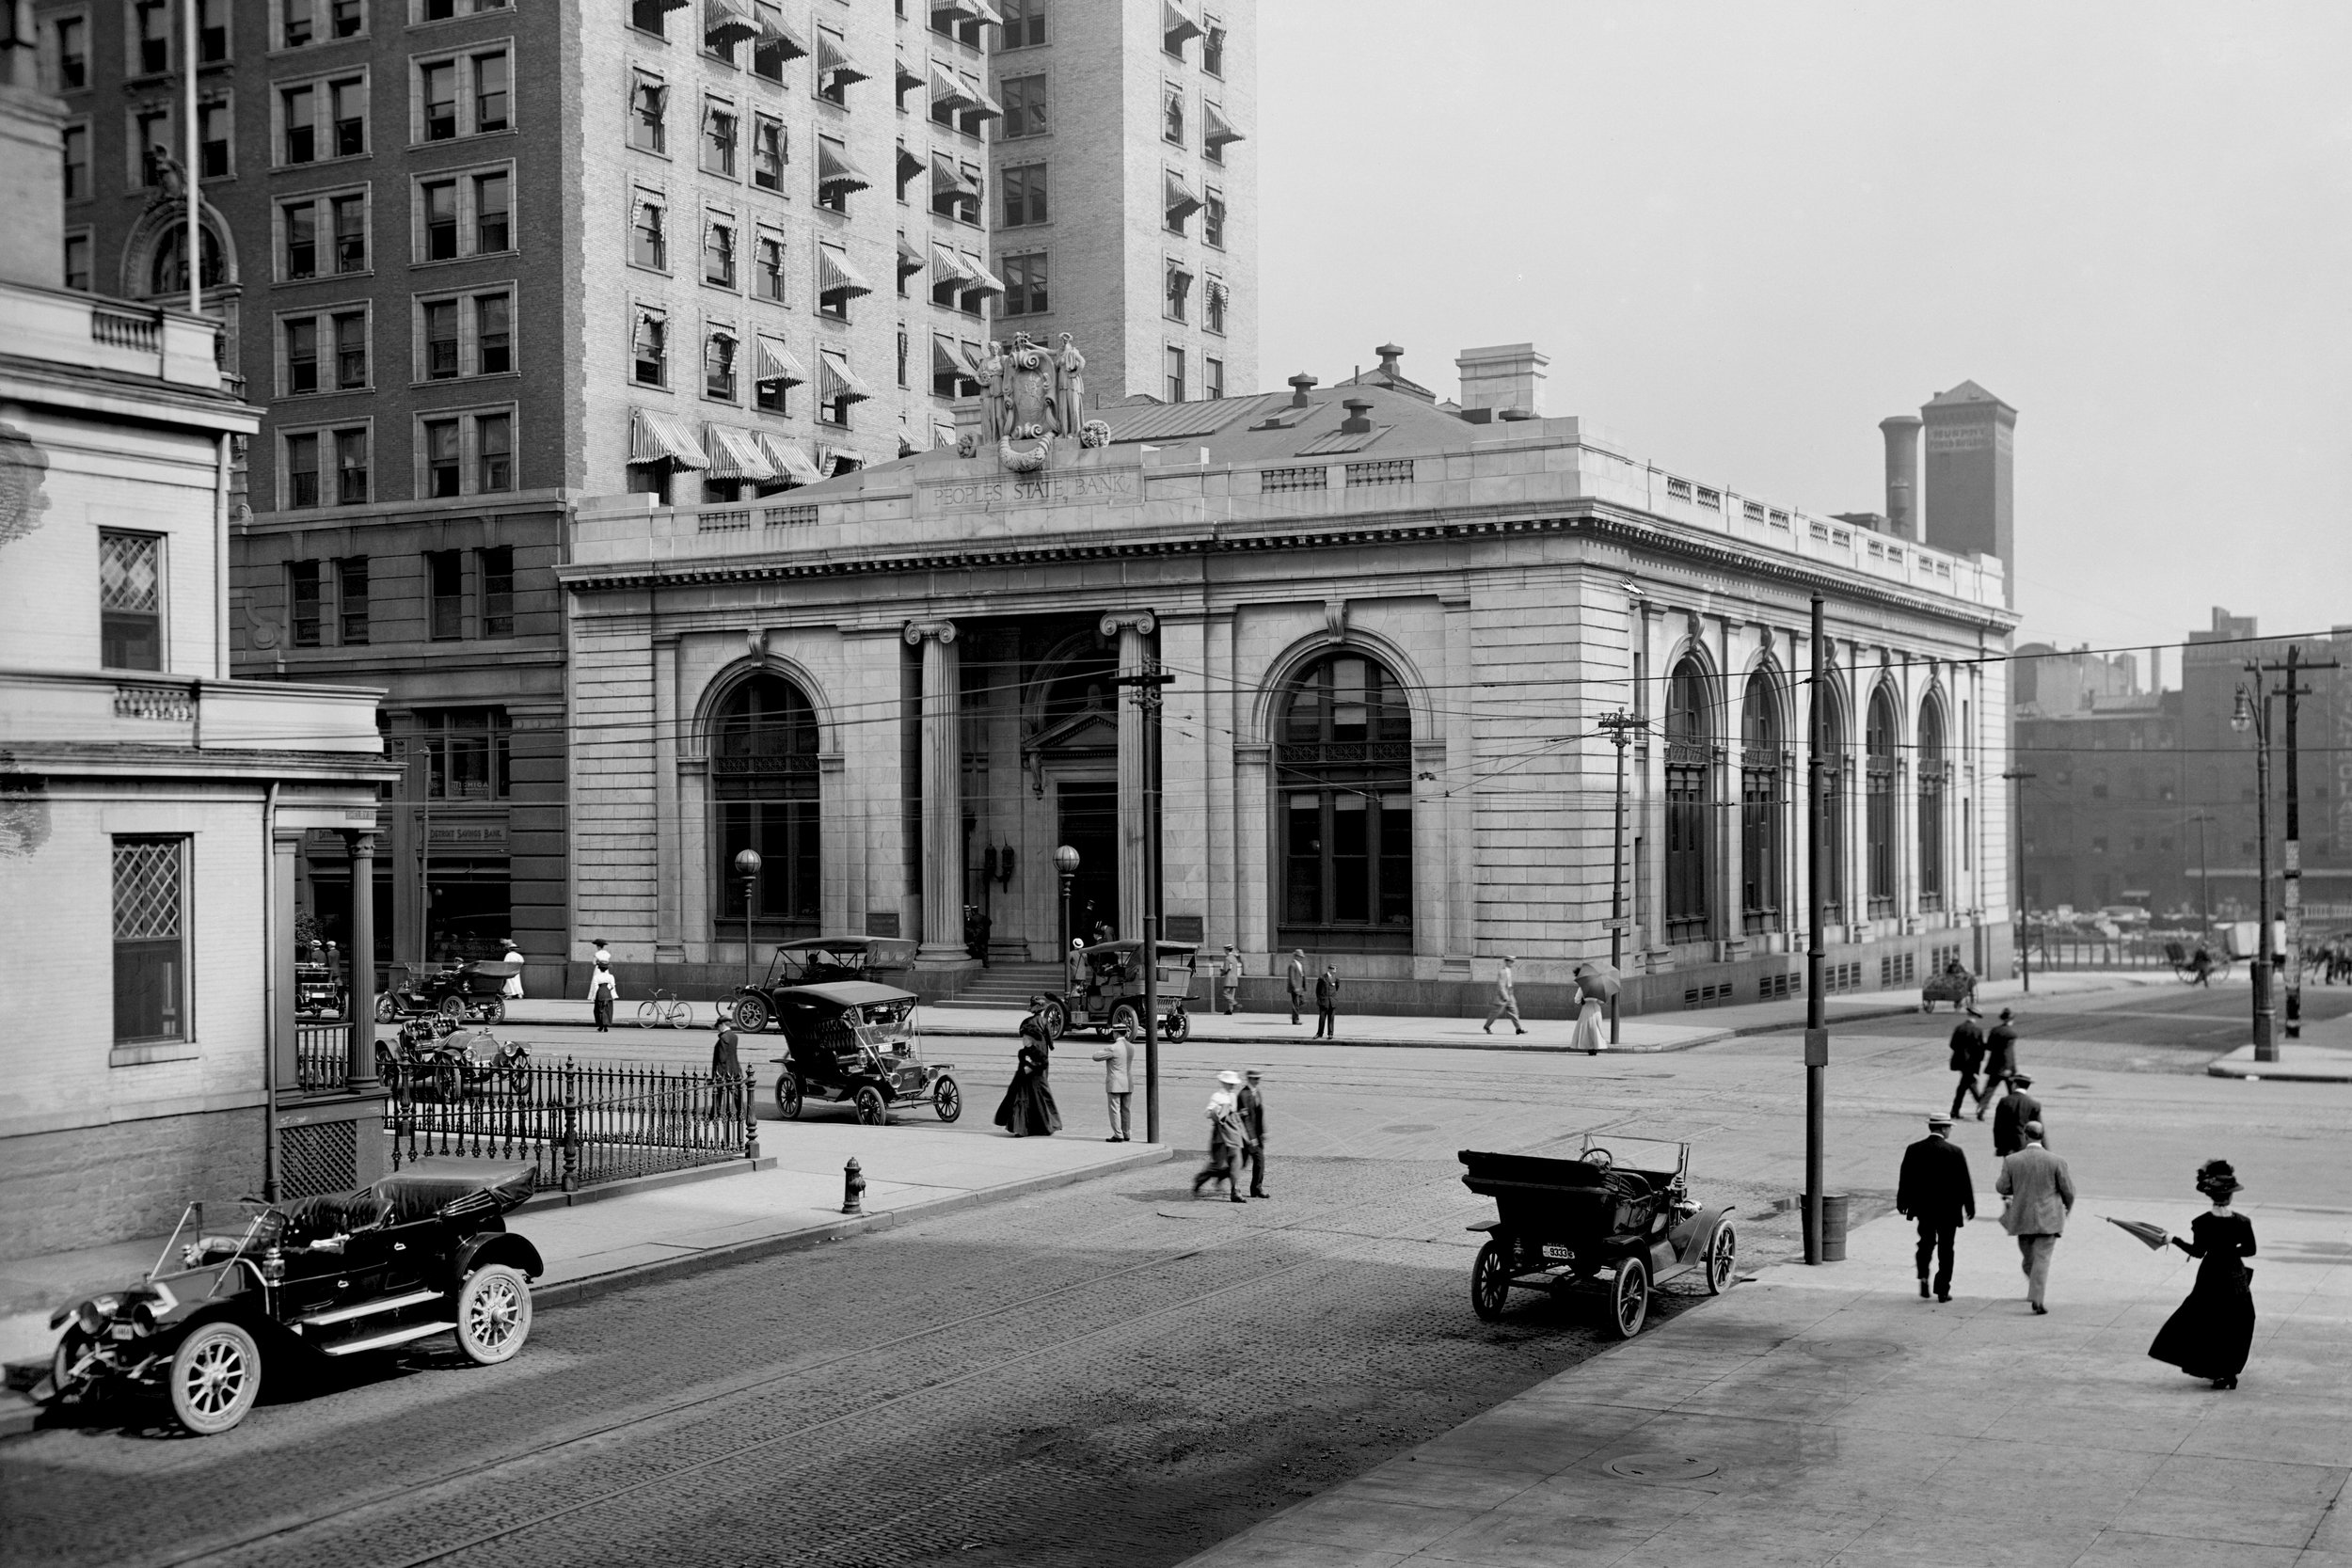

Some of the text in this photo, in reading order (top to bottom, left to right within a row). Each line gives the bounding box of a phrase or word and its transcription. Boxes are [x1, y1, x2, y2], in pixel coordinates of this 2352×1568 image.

[933, 475, 1125, 506] PEOPLES STATE BANK
[430, 829, 455, 839] DETROIT
[456, 829, 482, 839] SAVINGS
